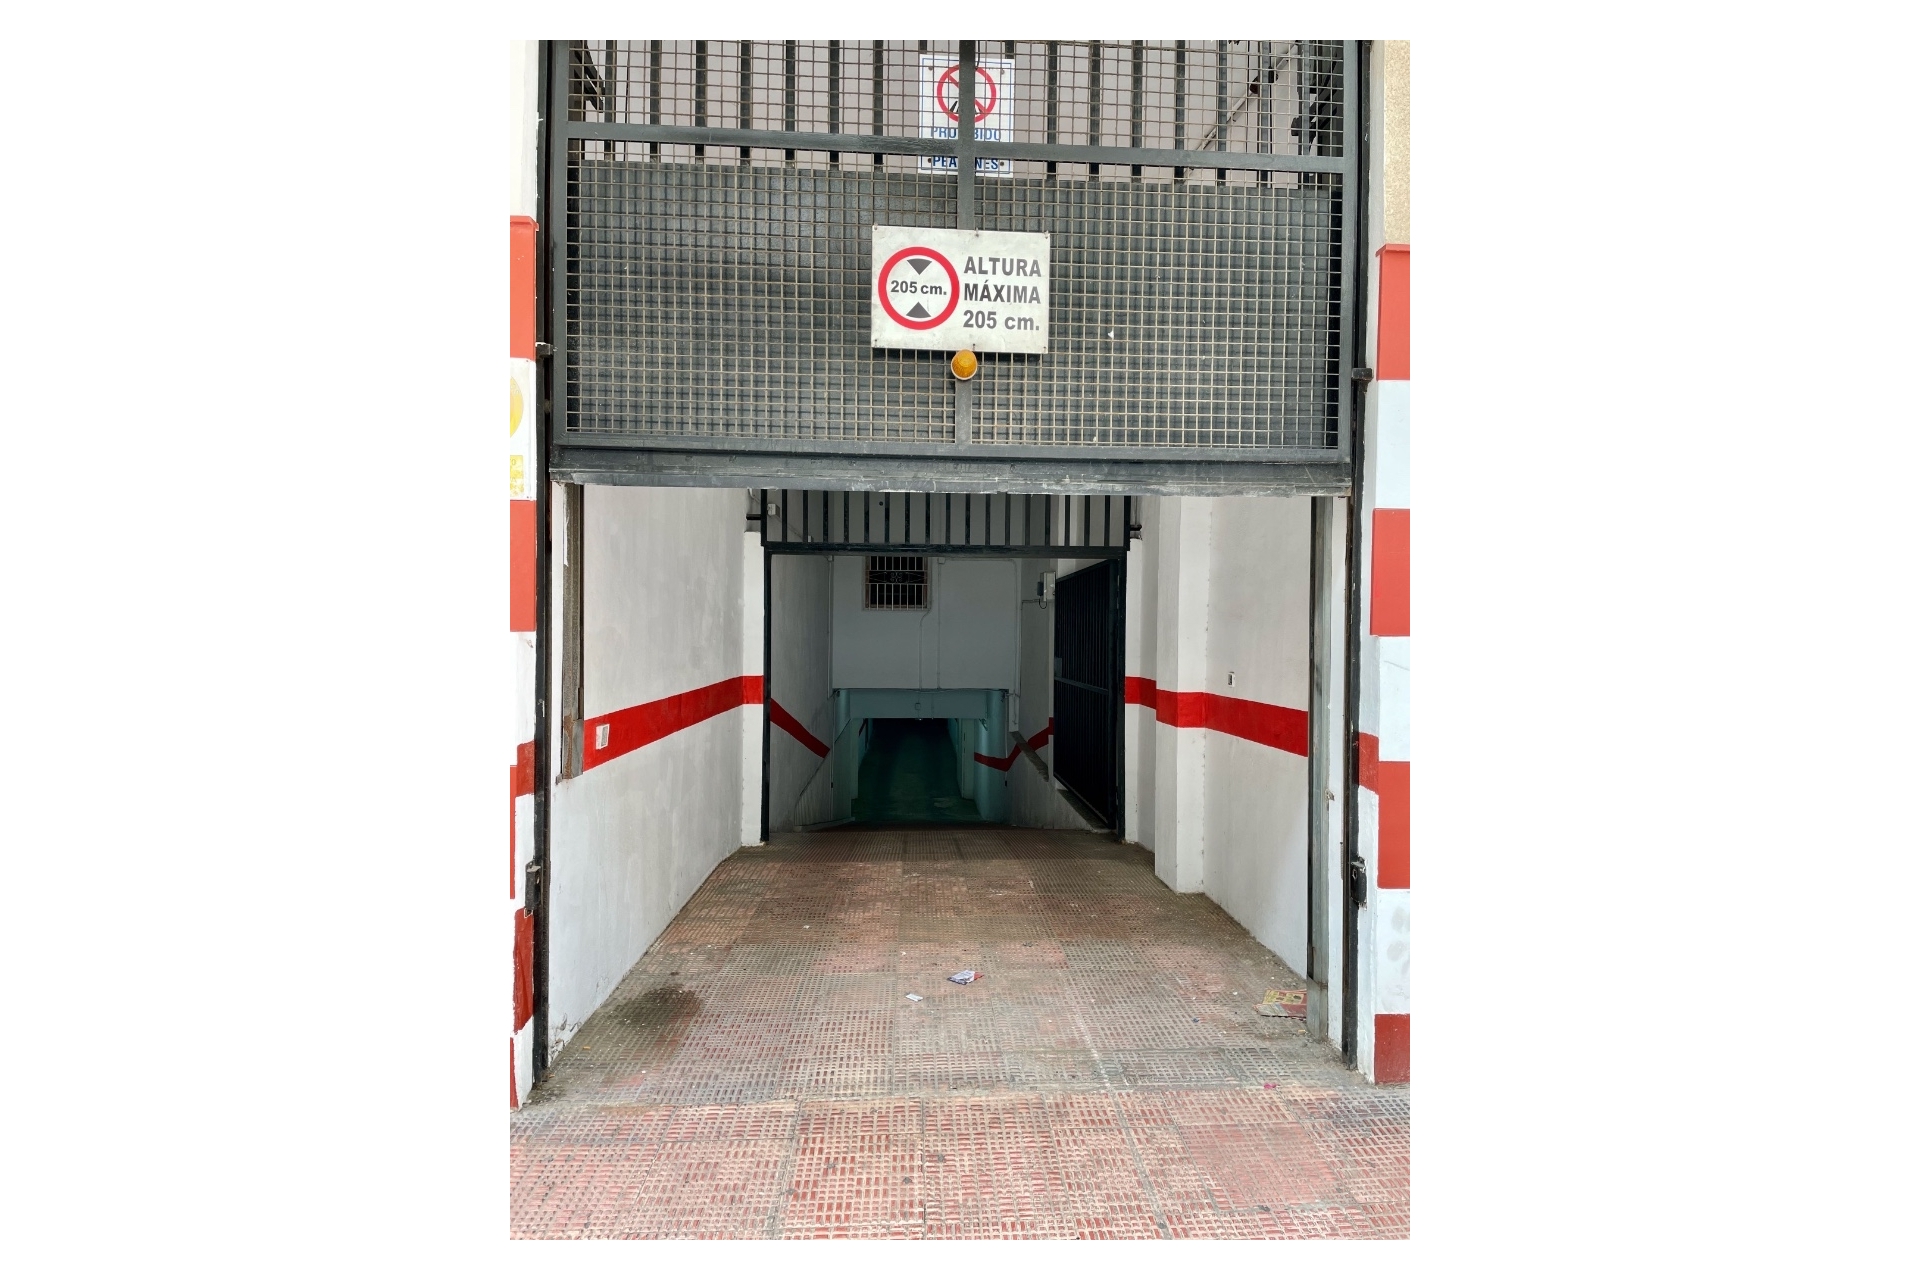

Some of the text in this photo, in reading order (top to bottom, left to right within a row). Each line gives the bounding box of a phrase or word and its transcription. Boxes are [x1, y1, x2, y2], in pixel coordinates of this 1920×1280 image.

[930, 127, 1002, 141] PROBIDO
[932, 155, 999, 170] PEANES
[963, 256, 1042, 277] ALTURA
[890, 280, 947, 296] 205 cm.
[964, 279, 1041, 304] MÁXIMA
[963, 310, 1040, 331] 205 cm.
